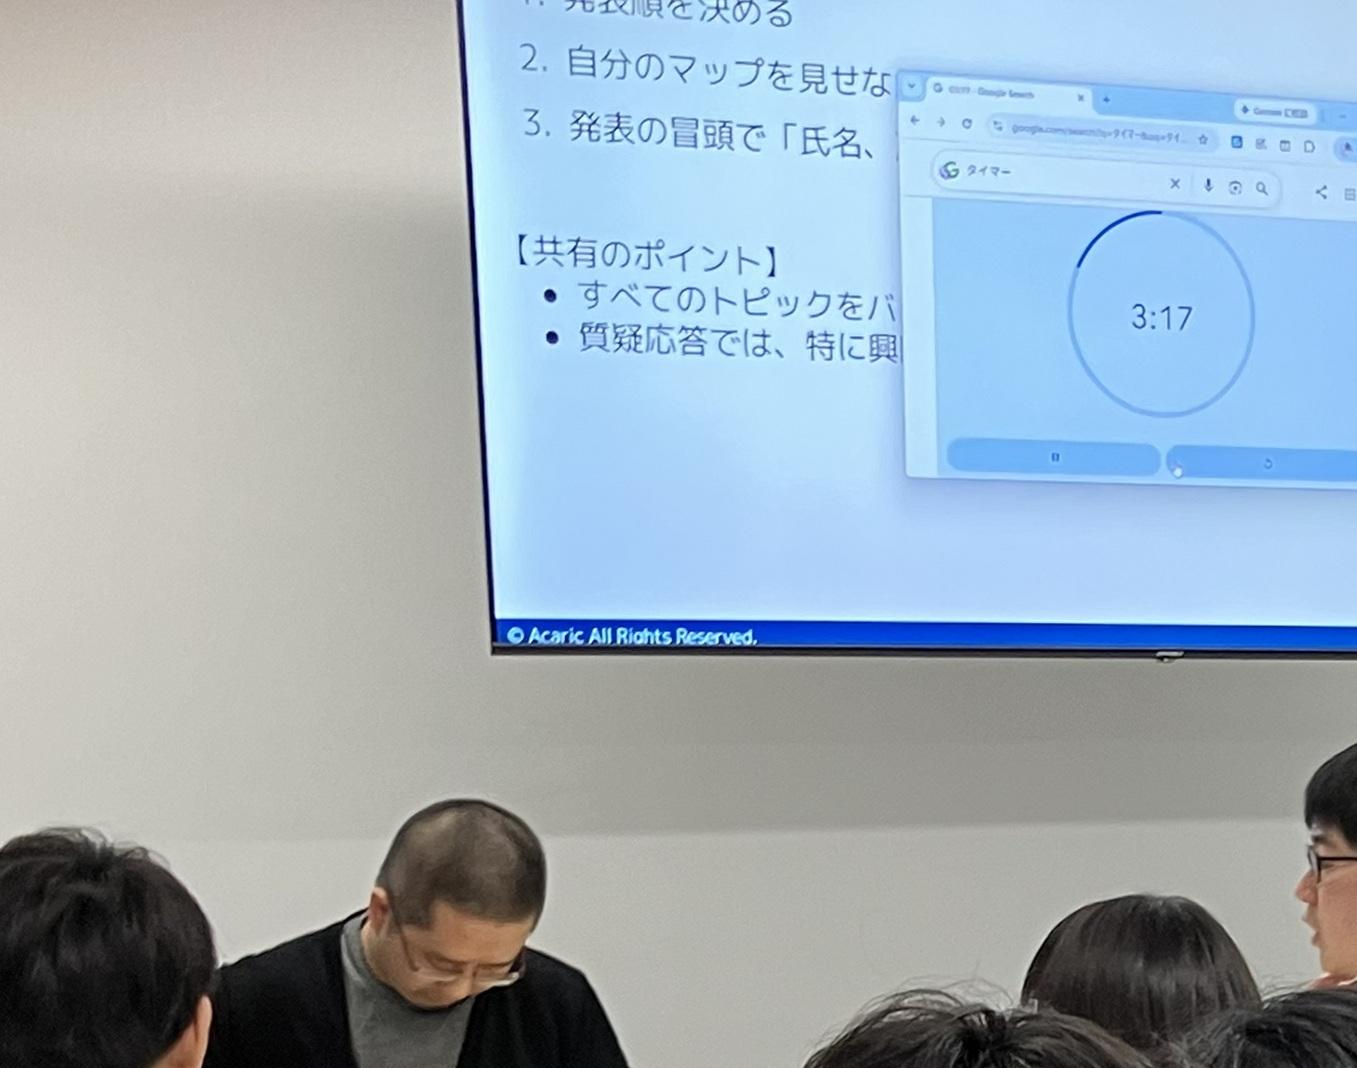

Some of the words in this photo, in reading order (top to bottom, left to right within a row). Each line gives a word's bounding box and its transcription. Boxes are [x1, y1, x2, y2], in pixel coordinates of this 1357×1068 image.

[519, 43, 548, 73] 2.
[568, 43, 892, 97] 自分のマップを見せな
[523, 108, 551, 137] 3.
[570, 109, 874, 159] 発表の冒頭で「氏名、
[517, 234, 776, 277] 【共有のポイント】
[578, 280, 897, 321] すべてのトピックをバ
[1131, 303, 1193, 331] 3:17
[580, 322, 898, 363] 質疑応答では、特に興
[528, 627, 584, 645] Acaric
[589, 627, 612, 645] All
[616, 627, 673, 645] Rights
[676, 628, 758, 646] Reserved.
